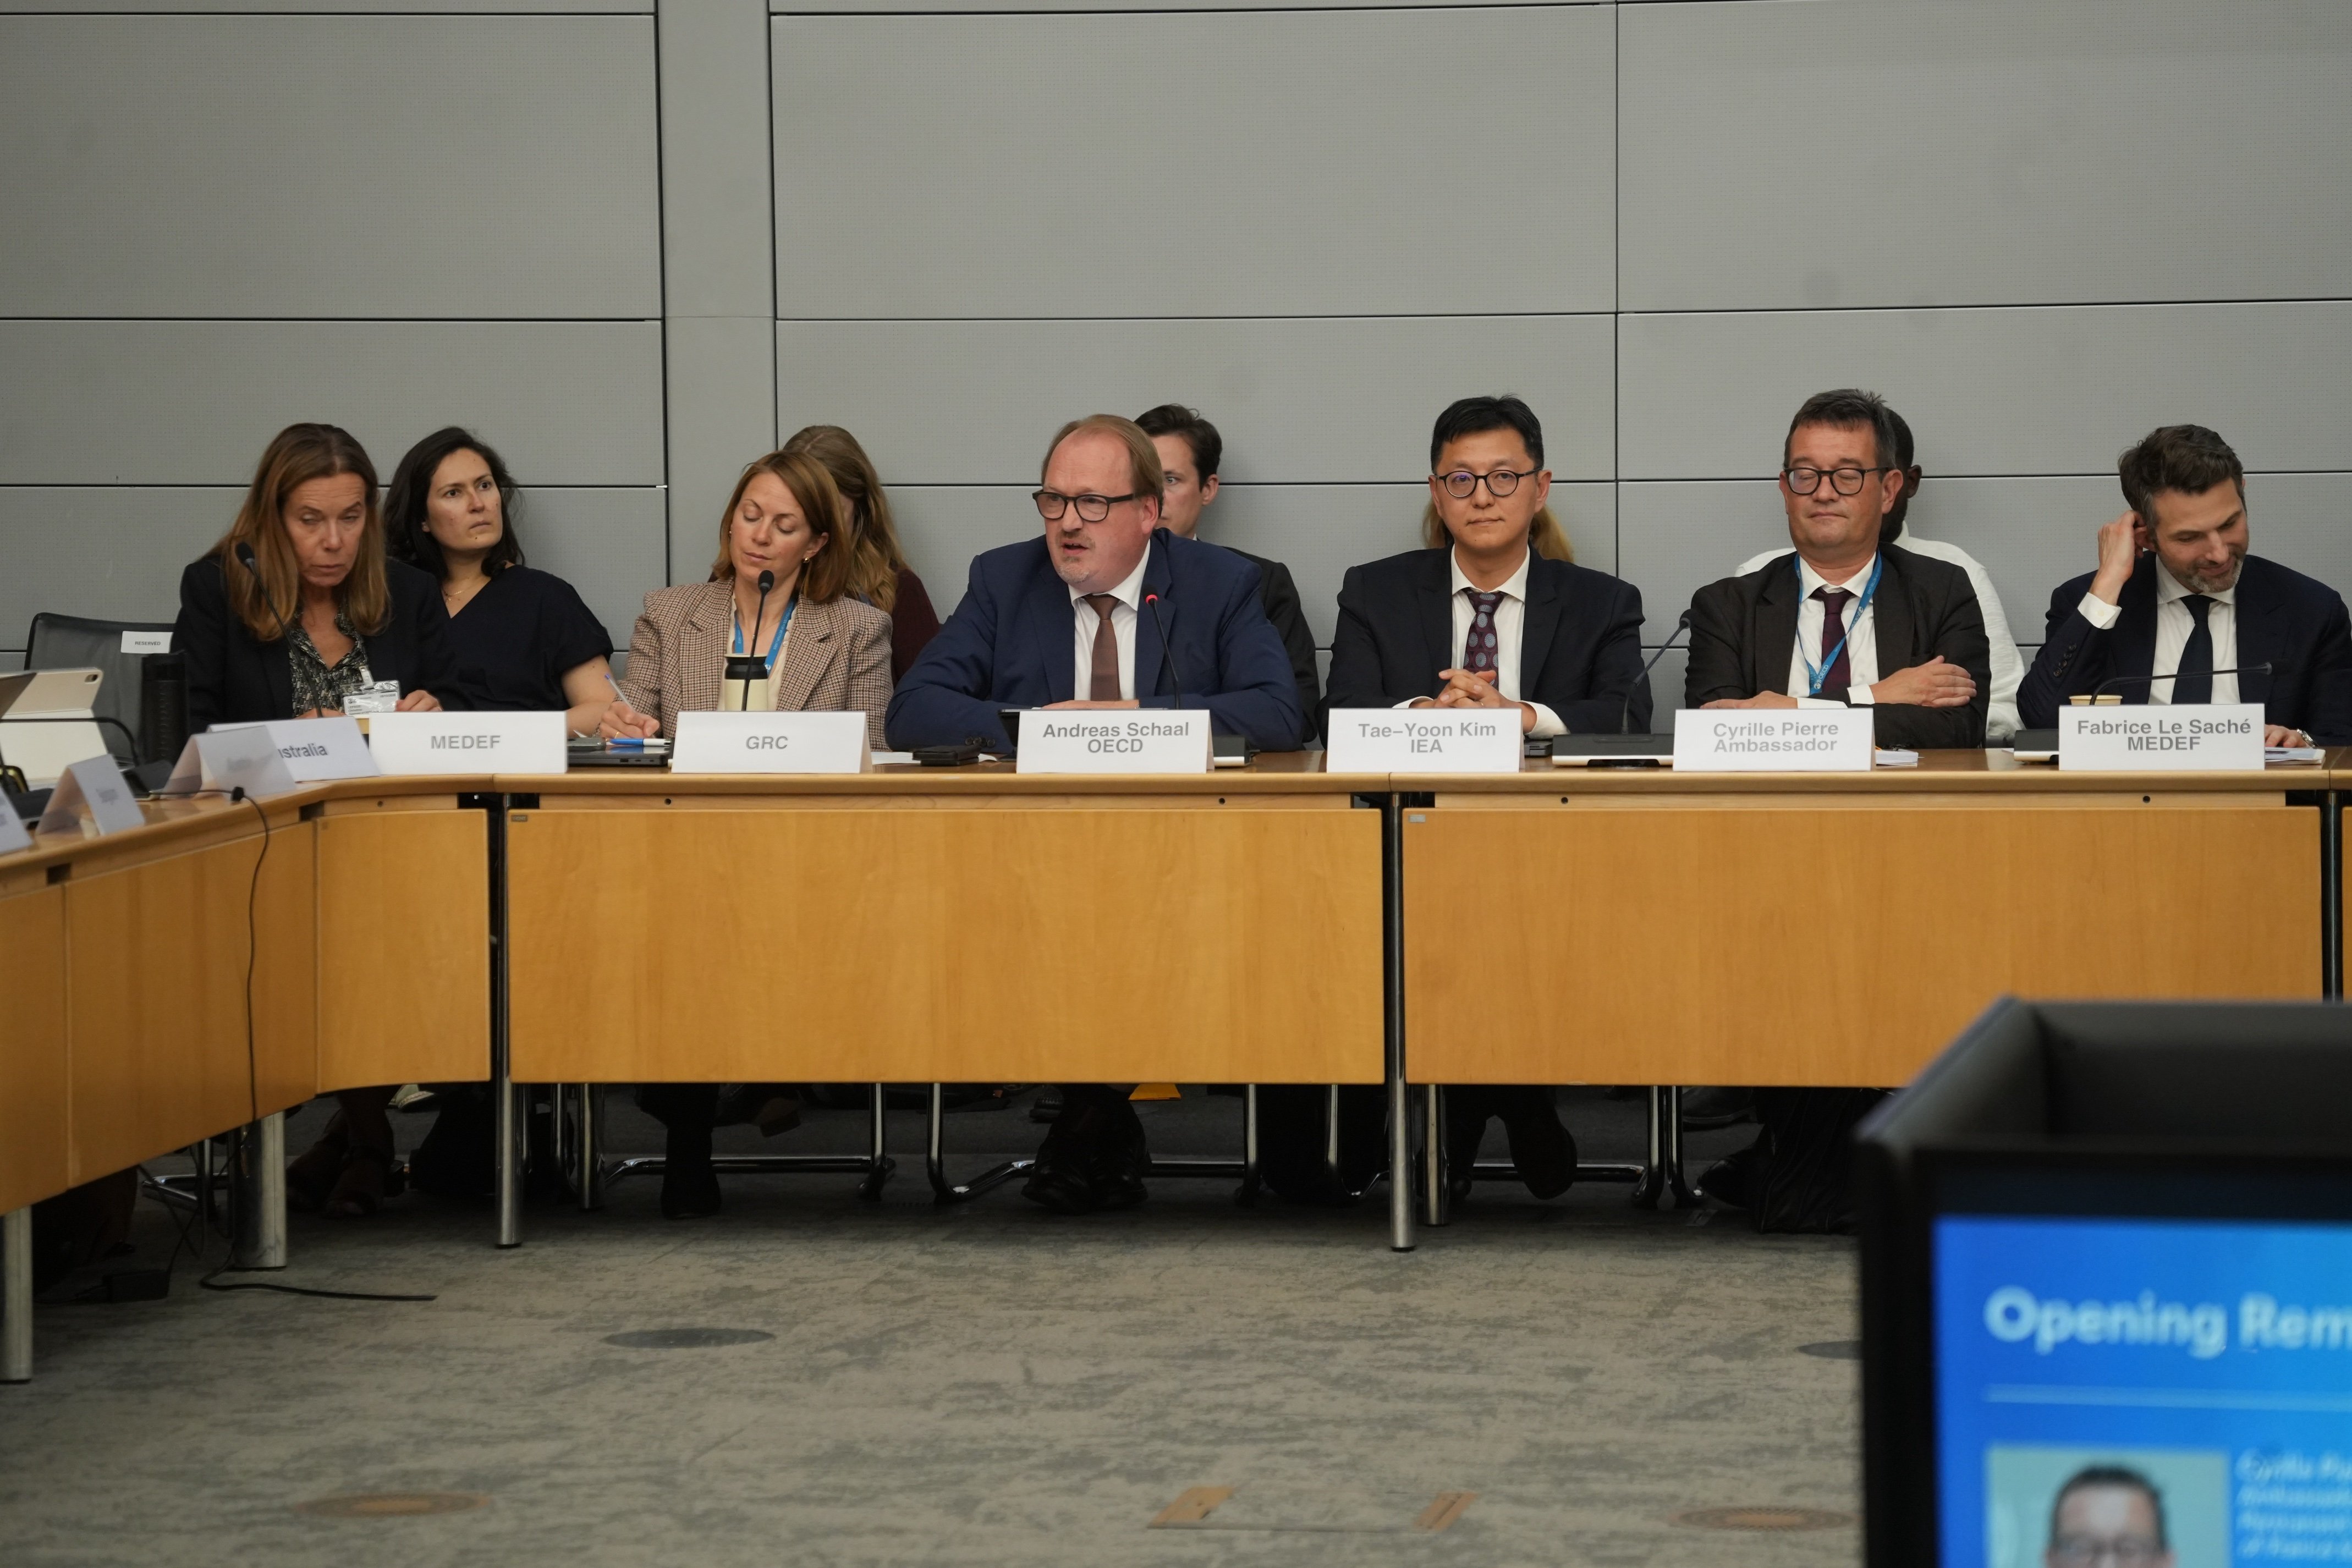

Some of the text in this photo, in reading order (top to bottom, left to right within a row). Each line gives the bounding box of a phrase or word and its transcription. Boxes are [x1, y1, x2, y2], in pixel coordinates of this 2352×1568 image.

[1818, 664, 1829, 680] OECD
[1042, 722, 1189, 738] Andreas Schaal
[1460, 722, 1496, 736] Kim
[1713, 722, 1839, 740] Cyrille Pierre
[2078, 718, 2251, 735] Fabrice Le Saché
[430, 735, 501, 749] MEDEF
[745, 735, 788, 750] GRC
[1087, 738, 1143, 753] OECD
[1410, 739, 1443, 753] IEA
[1713, 738, 1838, 753] Ambassador
[2128, 736, 2201, 751] MEDEF
[278, 743, 328, 759] stralia
[1984, 1285, 2228, 1360] Opening
